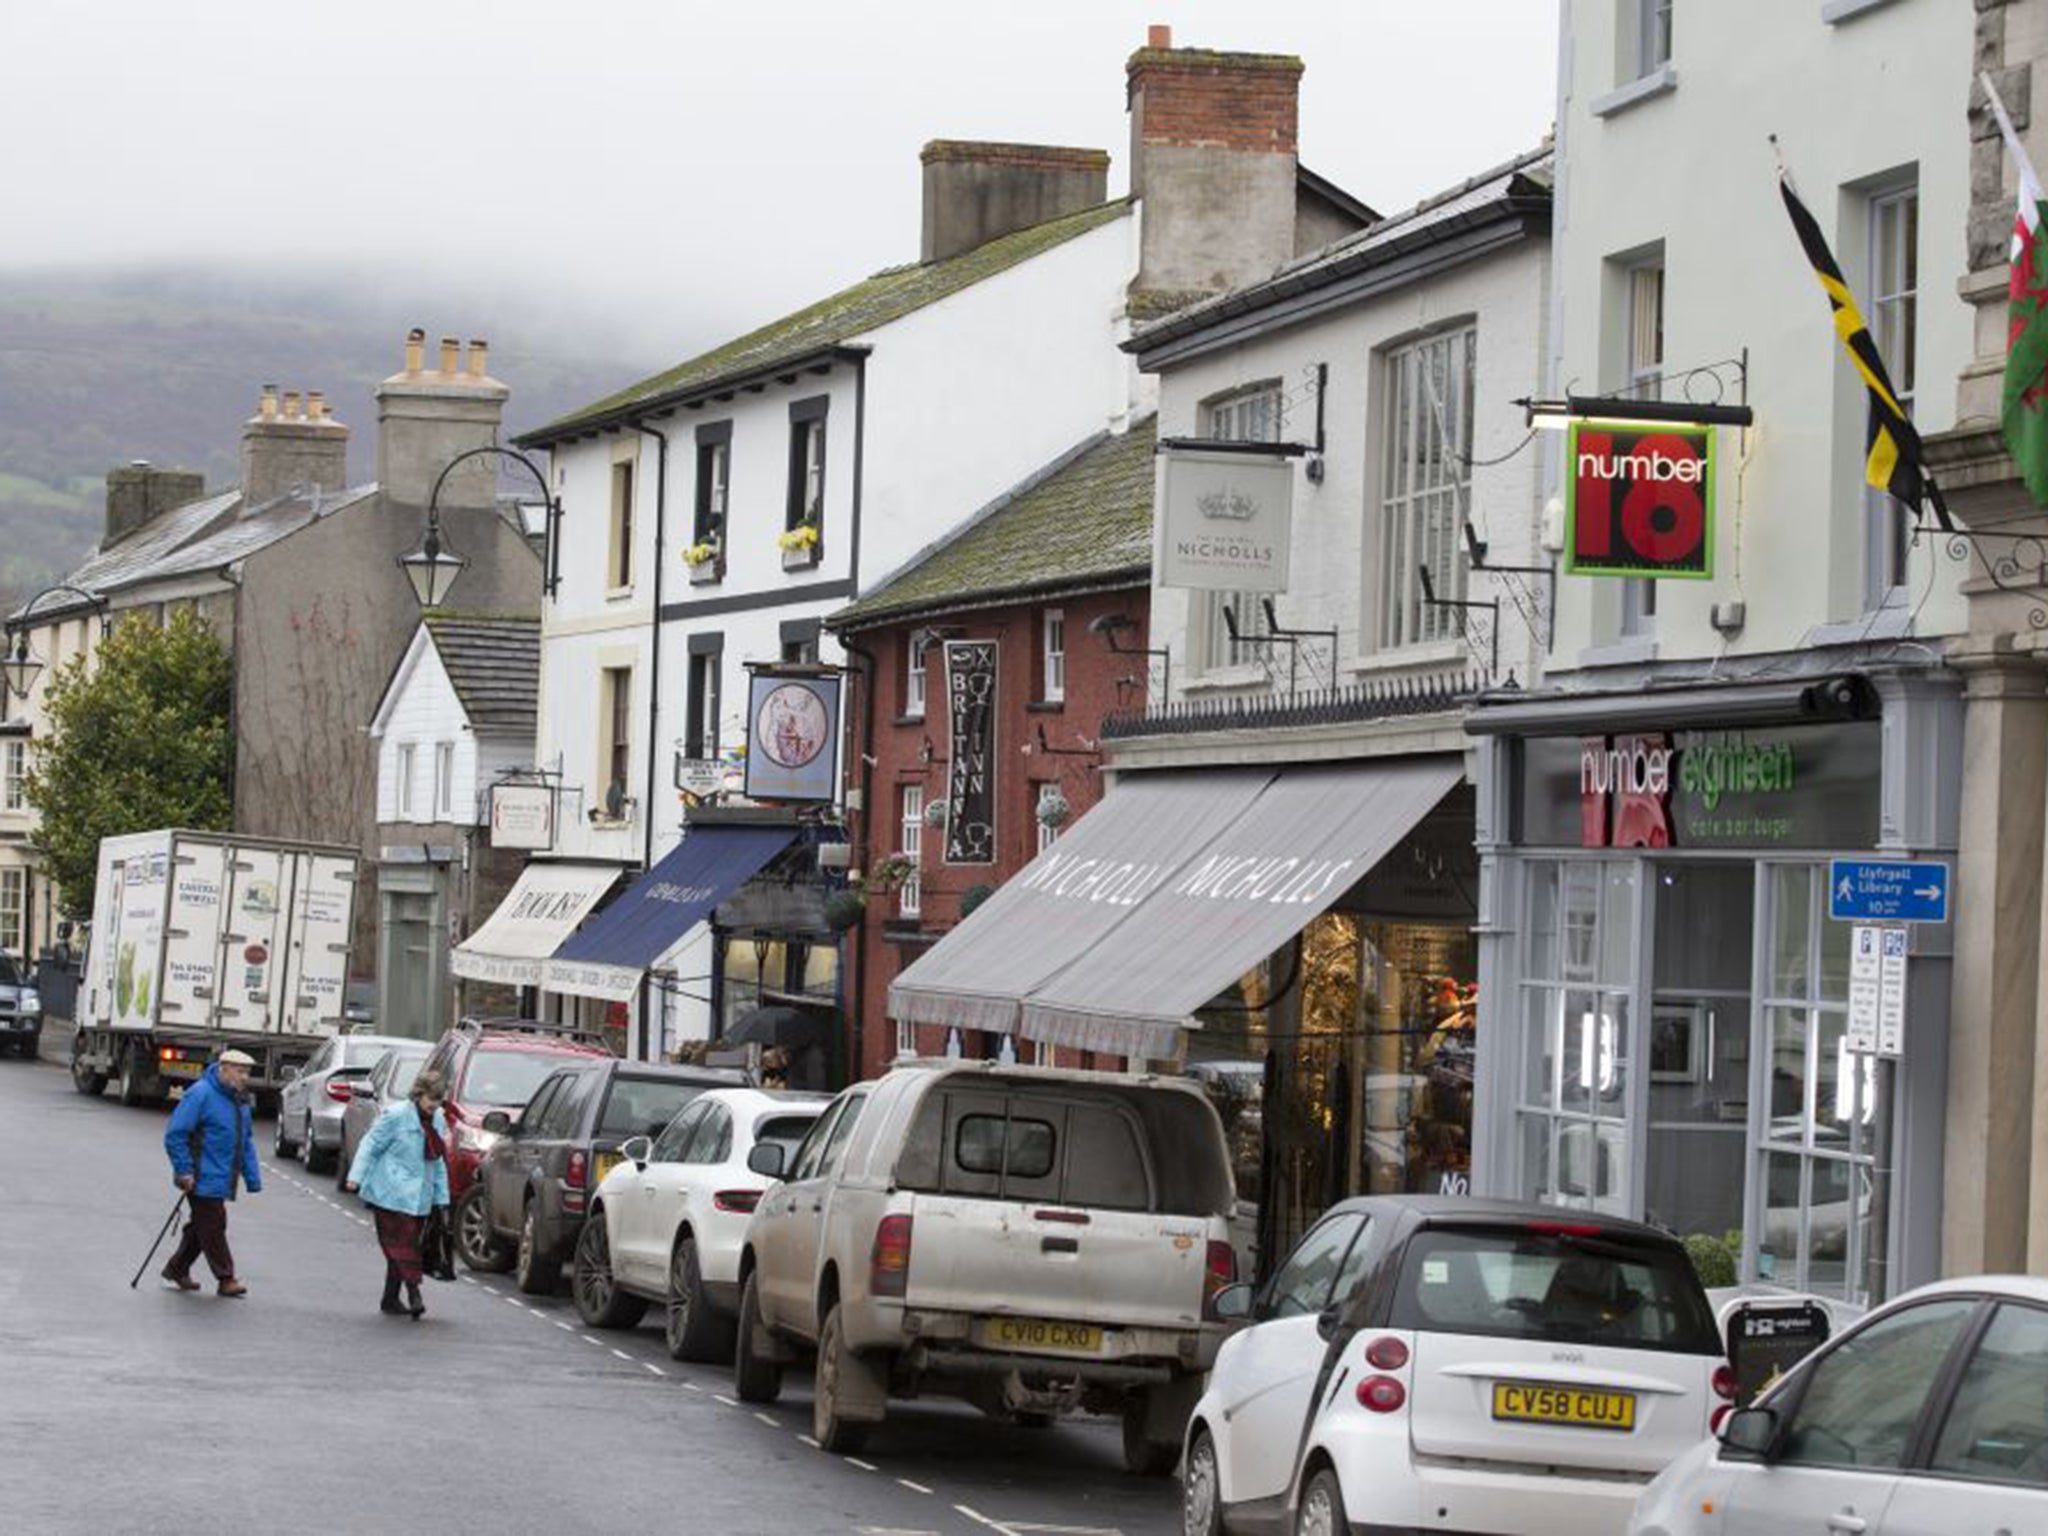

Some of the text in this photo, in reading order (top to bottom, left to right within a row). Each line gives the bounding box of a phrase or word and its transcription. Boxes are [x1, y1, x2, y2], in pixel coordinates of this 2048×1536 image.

[1578, 450, 1707, 484] number
[1576, 432, 1704, 563] 18
[1177, 542, 1273, 561] NICHOLLS
[948, 673, 968, 858] BRITANNIA
[969, 732, 986, 794] INN
[1581, 737, 1795, 811] number eighteen
[1176, 853, 1354, 904] NICHOLLS
[1858, 881, 1903, 896] Library
[1001, 1318, 1091, 1346] CV10 CXO
[1504, 1387, 1625, 1422] CV58 CUJ
